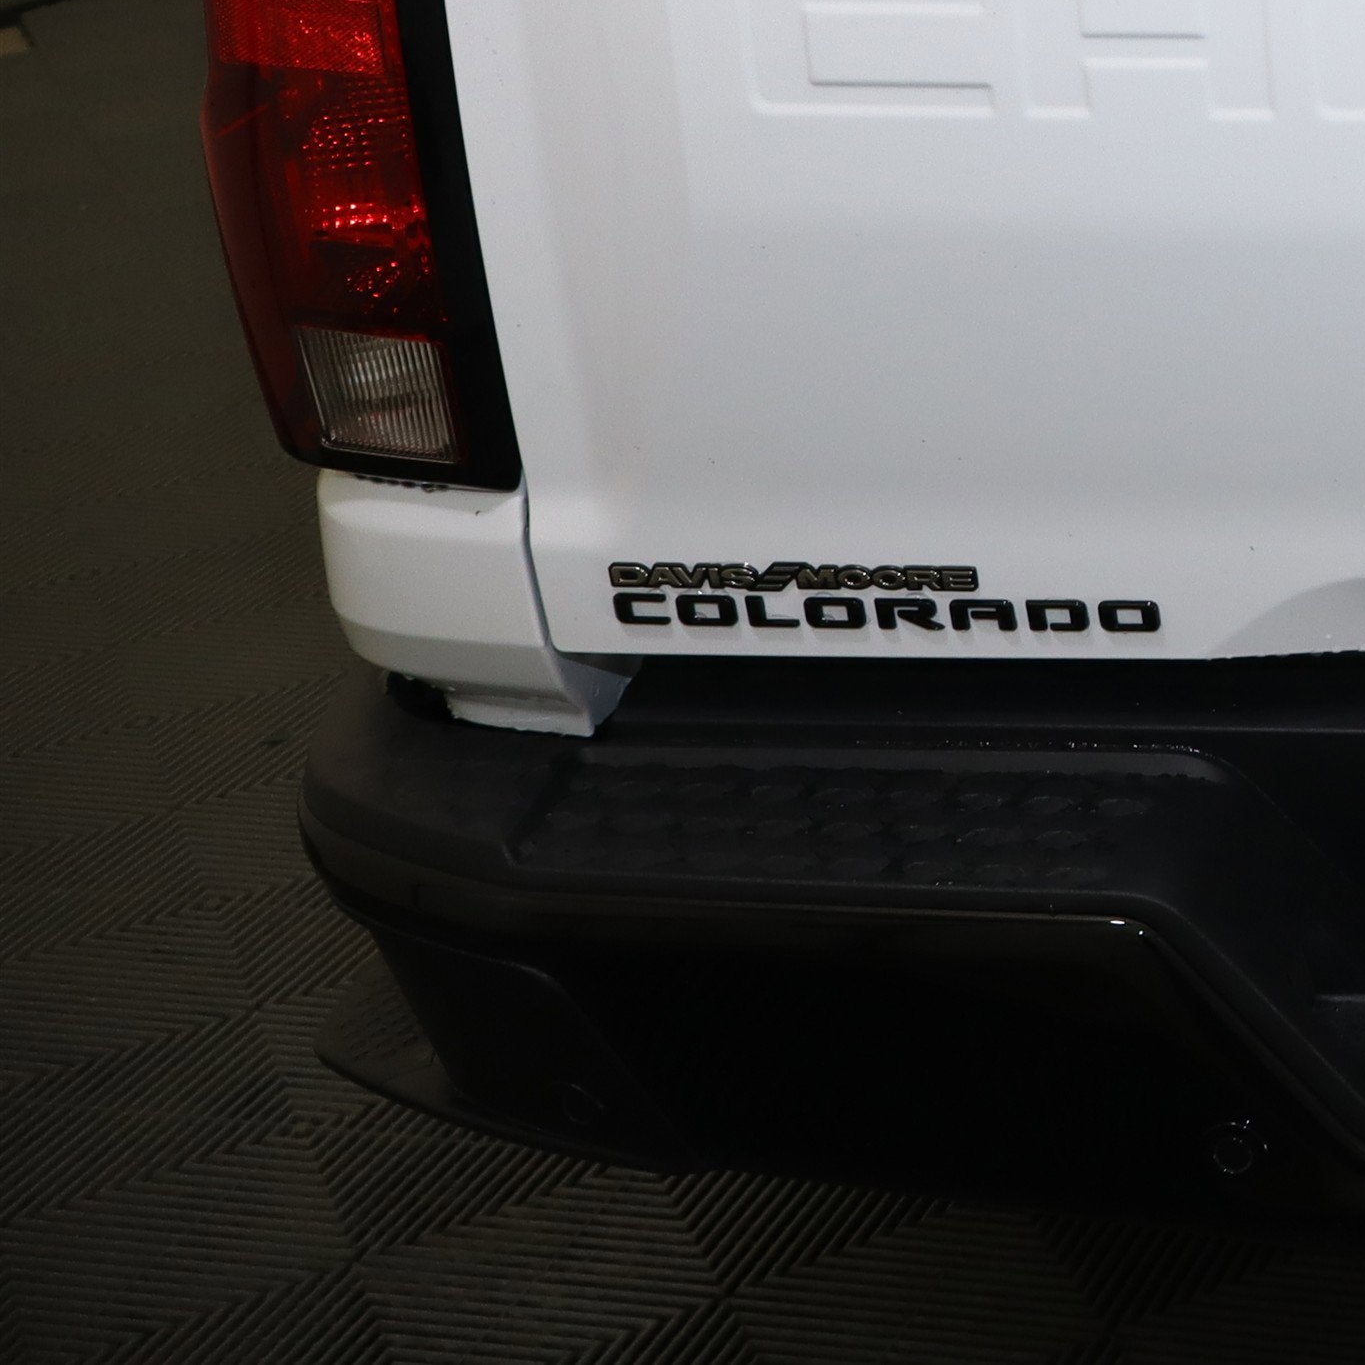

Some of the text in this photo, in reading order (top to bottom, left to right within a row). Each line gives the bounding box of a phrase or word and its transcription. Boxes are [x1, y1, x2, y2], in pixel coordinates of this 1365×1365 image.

[609, 562, 979, 591] DAVIS MOORE
[613, 593, 1161, 632] COLORADO
